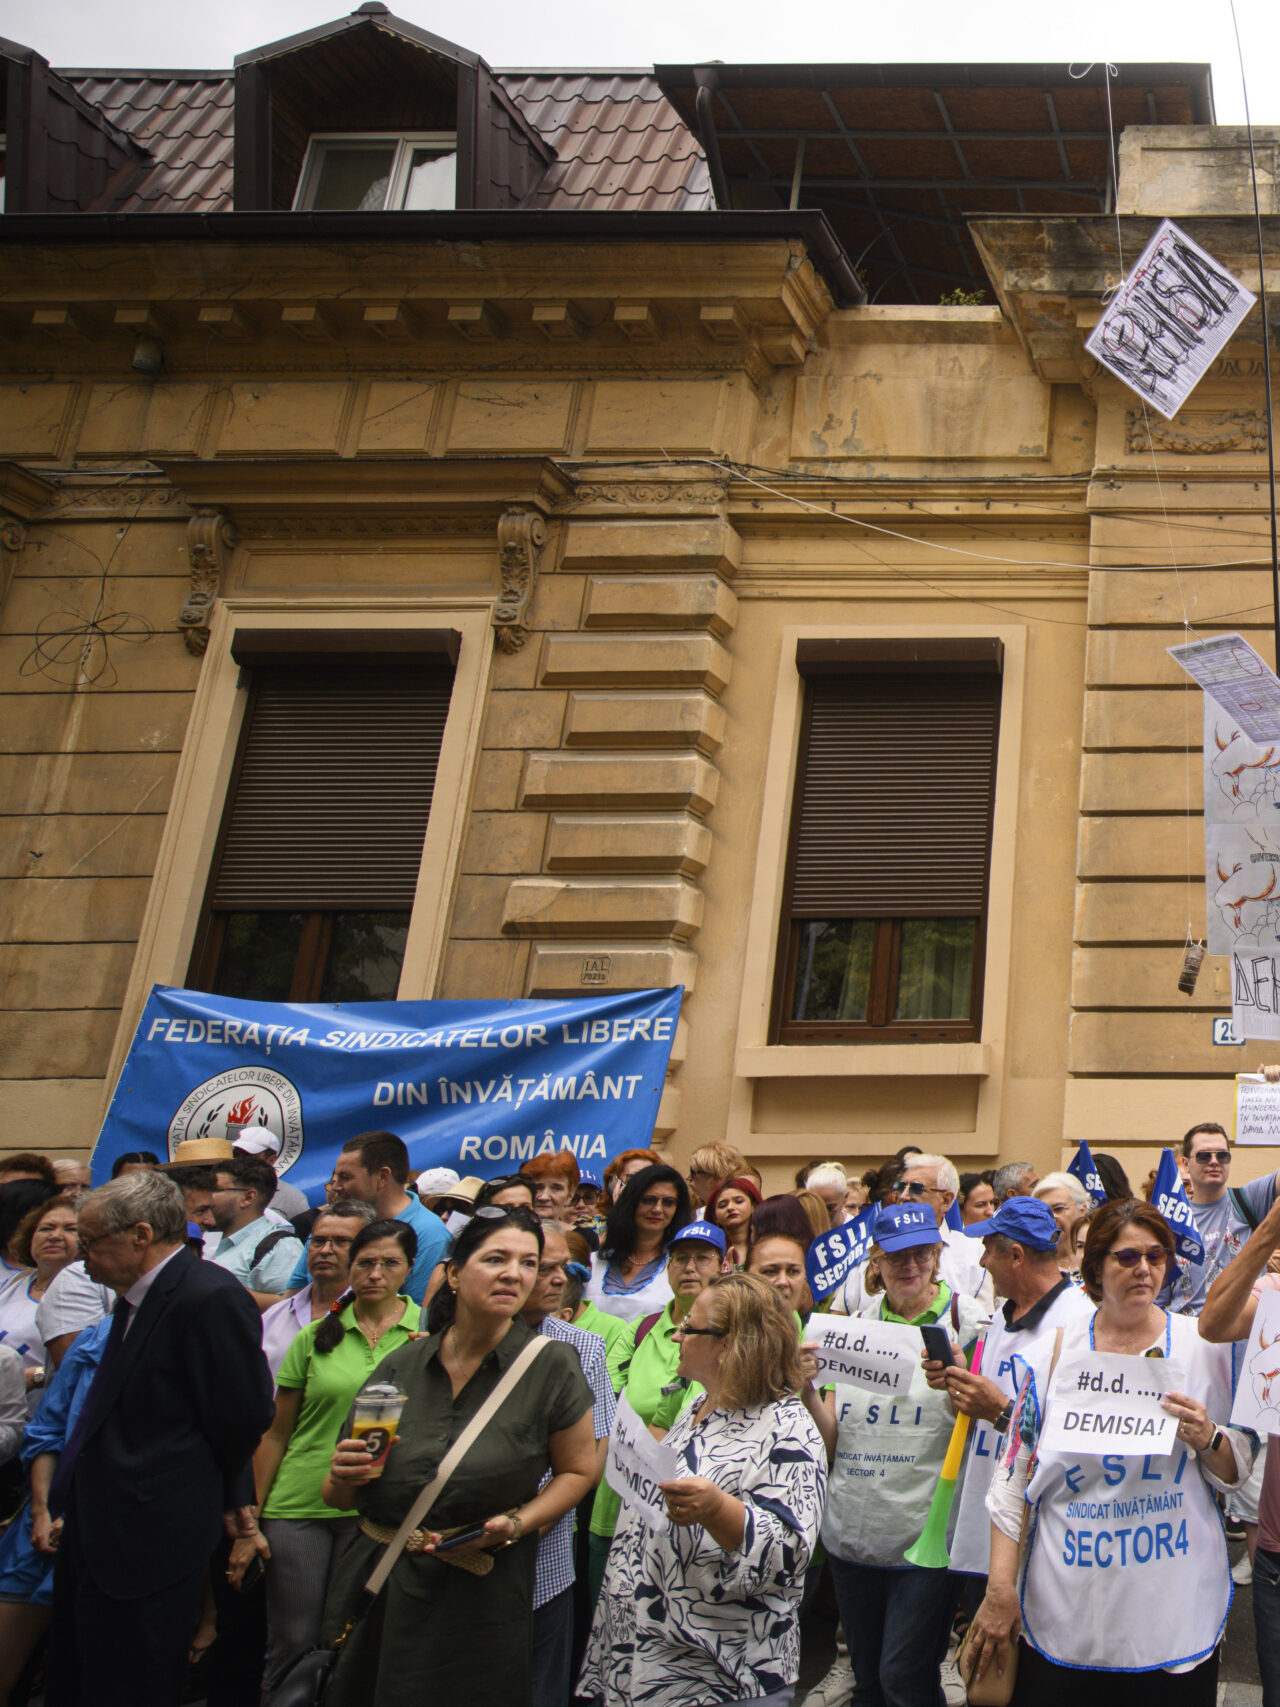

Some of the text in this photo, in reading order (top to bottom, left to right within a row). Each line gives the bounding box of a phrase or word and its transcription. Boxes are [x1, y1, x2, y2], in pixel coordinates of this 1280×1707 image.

[319, 1024, 549, 1049] SINDICATELOR
[562, 1017, 674, 1044] LIBERE
[183, 1071, 255, 1114] SINDICATELOR
[256, 1072, 287, 1092] LIBERE
[282, 1088, 297, 1108] DIN
[373, 1082, 428, 1106] DIN
[1242, 1124, 1264, 1135] DAVID
[459, 1129, 607, 1161] ROMÂNIA
[579, 1170, 596, 1181] SLI
[894, 1212, 924, 1229] FSLI
[1157, 1192, 1199, 1233] SECT
[683, 1226, 711, 1237] FSLI
[815, 1222, 867, 1269] FSLI
[814, 1243, 864, 1292] SECTOR
[818, 1357, 900, 1388] DEMISIA!
[840, 1402, 922, 1425] FSLI
[1063, 1411, 1166, 1437] DEMISIA!
[365, 1431, 382, 1452] 5
[837, 1451, 862, 1461] INDICAT
[846, 1467, 885, 1477] SECTOR 4
[1065, 1454, 1188, 1494] FSLI
[1066, 1502, 1110, 1519] SINDICAT
